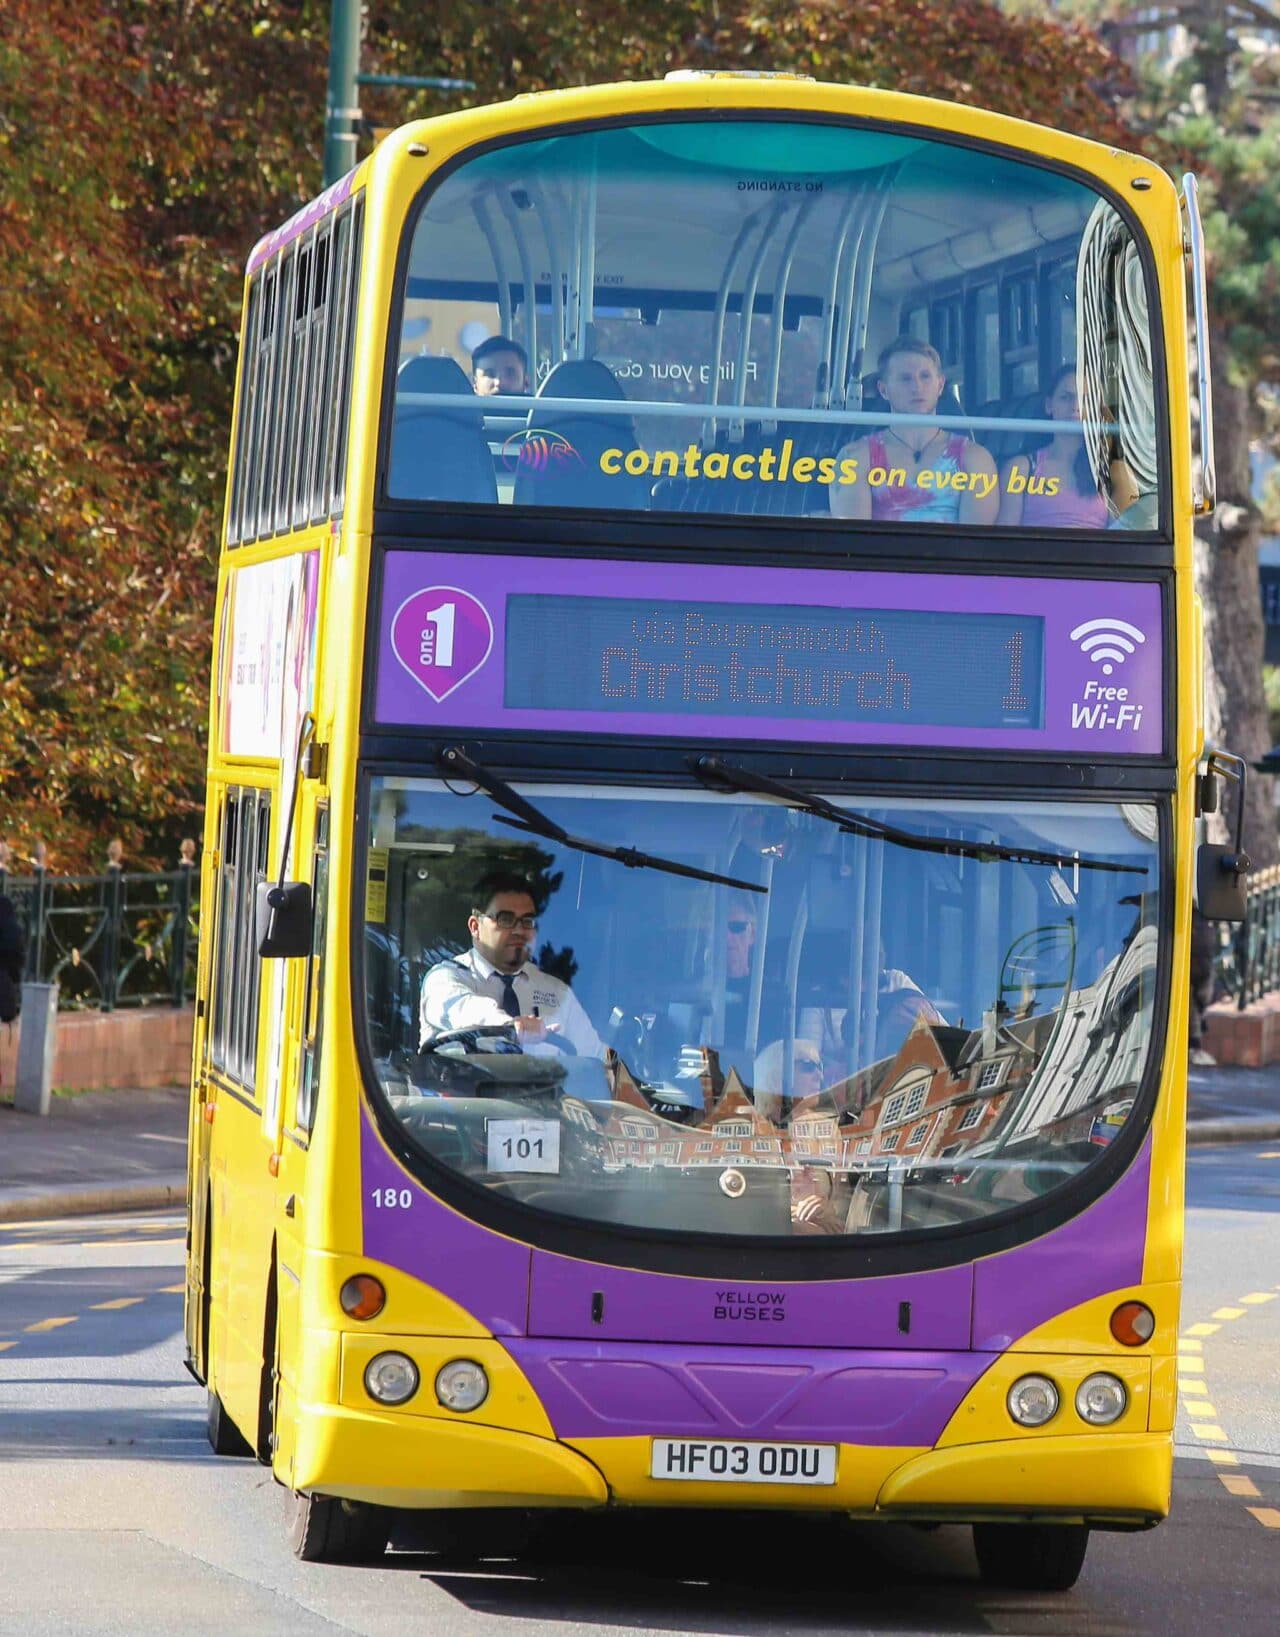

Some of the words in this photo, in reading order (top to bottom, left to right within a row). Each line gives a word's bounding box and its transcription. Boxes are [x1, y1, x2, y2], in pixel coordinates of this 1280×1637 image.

[599, 439, 858, 485] contactless
[868, 465, 906, 488] on
[916, 467, 998, 498] every
[1006, 465, 1060, 496] bus
[420, 628, 434, 666] one
[426, 602, 456, 667] 1
[632, 610, 675, 645] via
[685, 611, 888, 654] Bournemouth
[601, 646, 912, 711] Christchurch
[1002, 631, 1029, 711] 1
[1083, 680, 1129, 702] Free
[1070, 703, 1144, 732] Wi-Fi
[502, 1138, 545, 1159] 101
[371, 1188, 413, 1210] 180
[713, 1306, 786, 1322] BUSES
[715, 1291, 787, 1305] YELLOW
[666, 1443, 750, 1475] HF03
[758, 1446, 820, 1478] ODU
